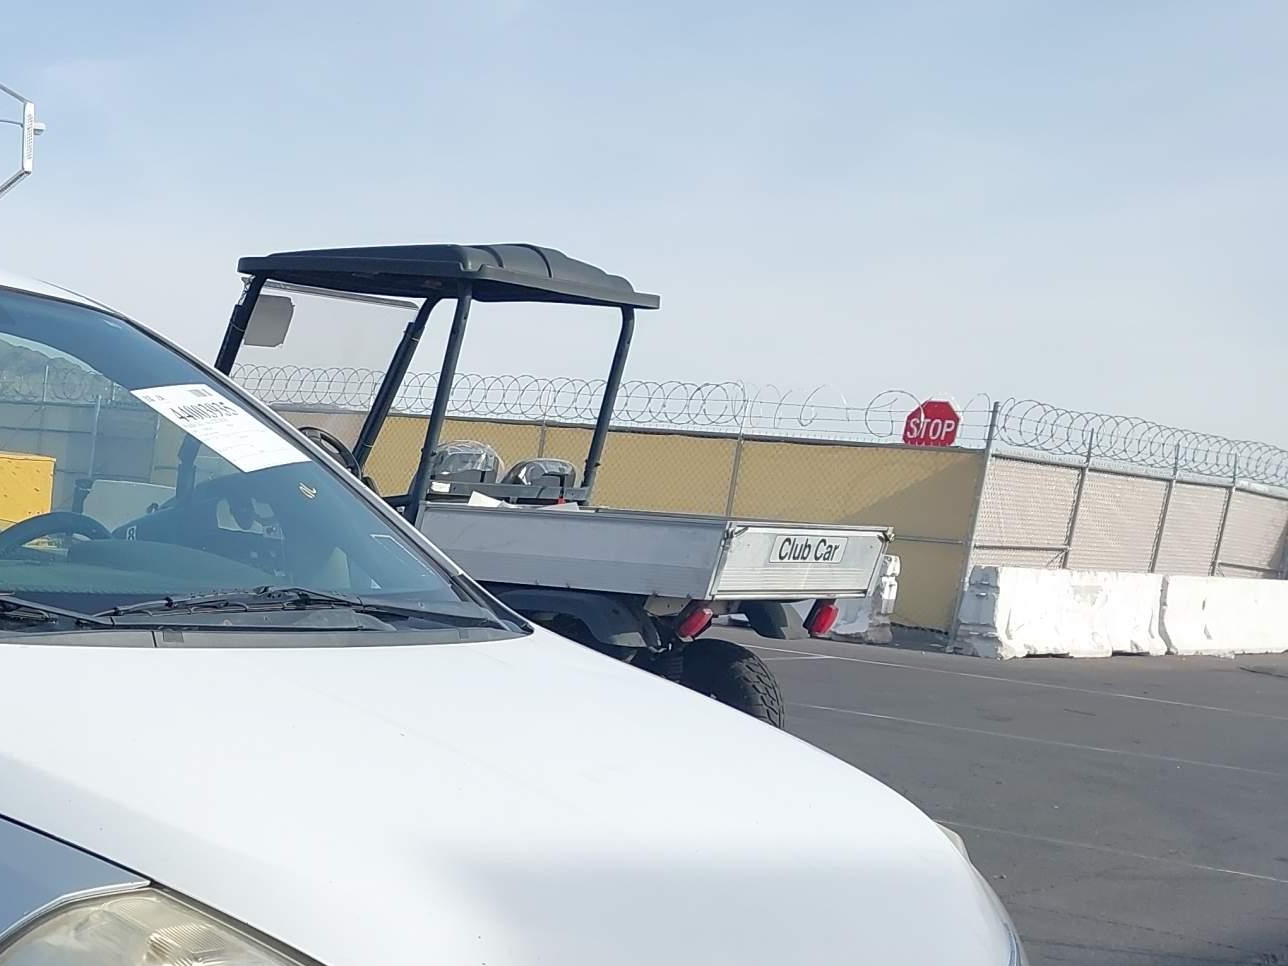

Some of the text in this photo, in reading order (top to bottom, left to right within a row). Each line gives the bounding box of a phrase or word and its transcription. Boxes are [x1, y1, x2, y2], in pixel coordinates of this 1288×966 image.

[907, 418, 956, 441] STOP
[778, 537, 840, 562] Club Car
